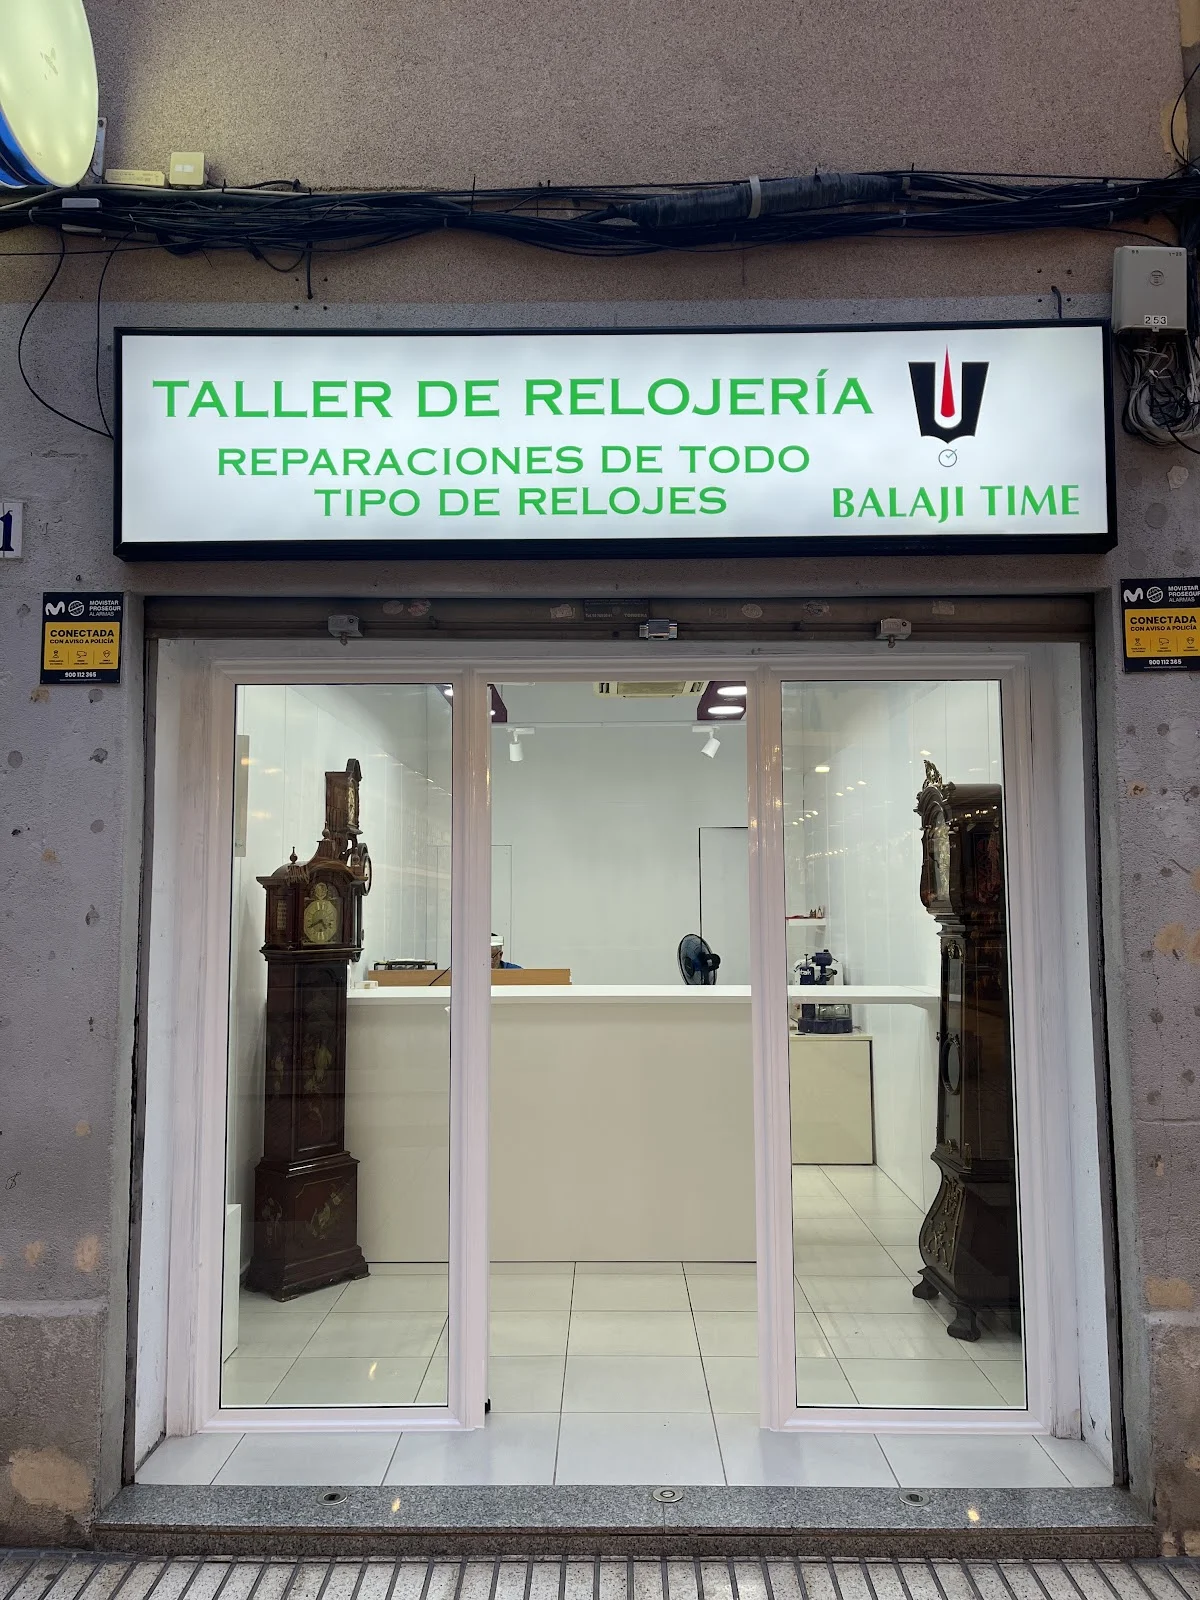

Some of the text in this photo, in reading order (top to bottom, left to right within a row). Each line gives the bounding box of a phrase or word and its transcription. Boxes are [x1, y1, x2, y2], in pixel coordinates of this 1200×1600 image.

[1144, 316, 1167, 324] 253
[152, 369, 872, 418] TALLER DE RELOJERÍA
[218, 445, 810, 476] REPARACIONES DE TODO
[314, 486, 727, 517] TIPO DE RELOJES
[833, 485, 1079, 523] BALAJI TIME
[50, 630, 114, 638] CONECTADA
[1130, 616, 1197, 624] CONECTADA
